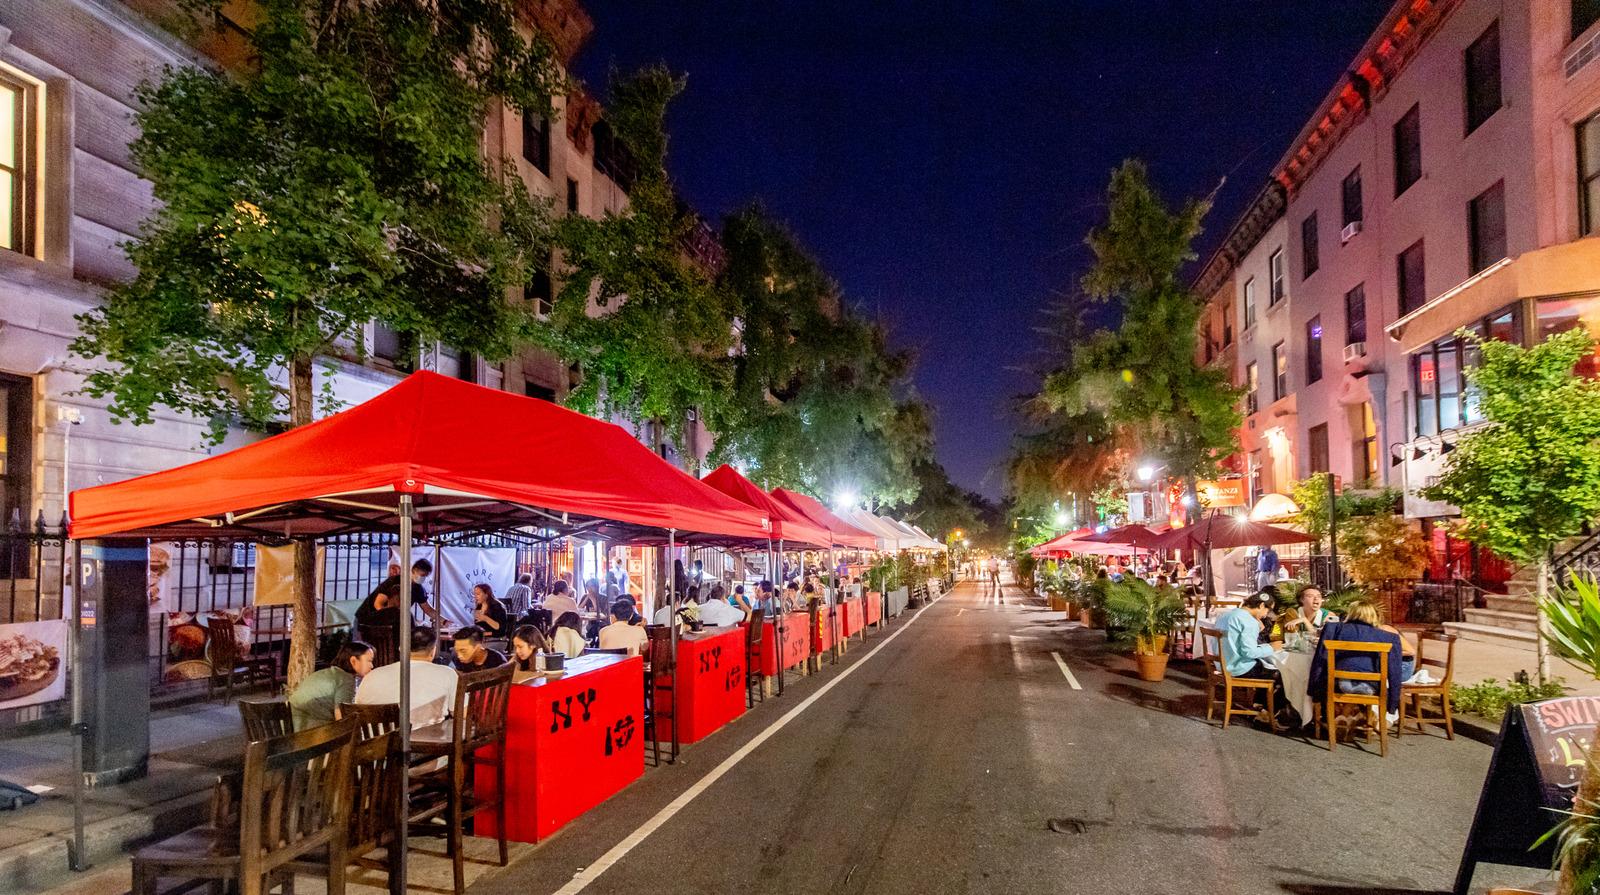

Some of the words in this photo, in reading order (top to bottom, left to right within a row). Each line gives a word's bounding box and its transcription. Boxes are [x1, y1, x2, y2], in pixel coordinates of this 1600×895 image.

[465, 569, 493, 580] PURE
[700, 646, 722, 674] NY
[551, 688, 596, 734] NY
